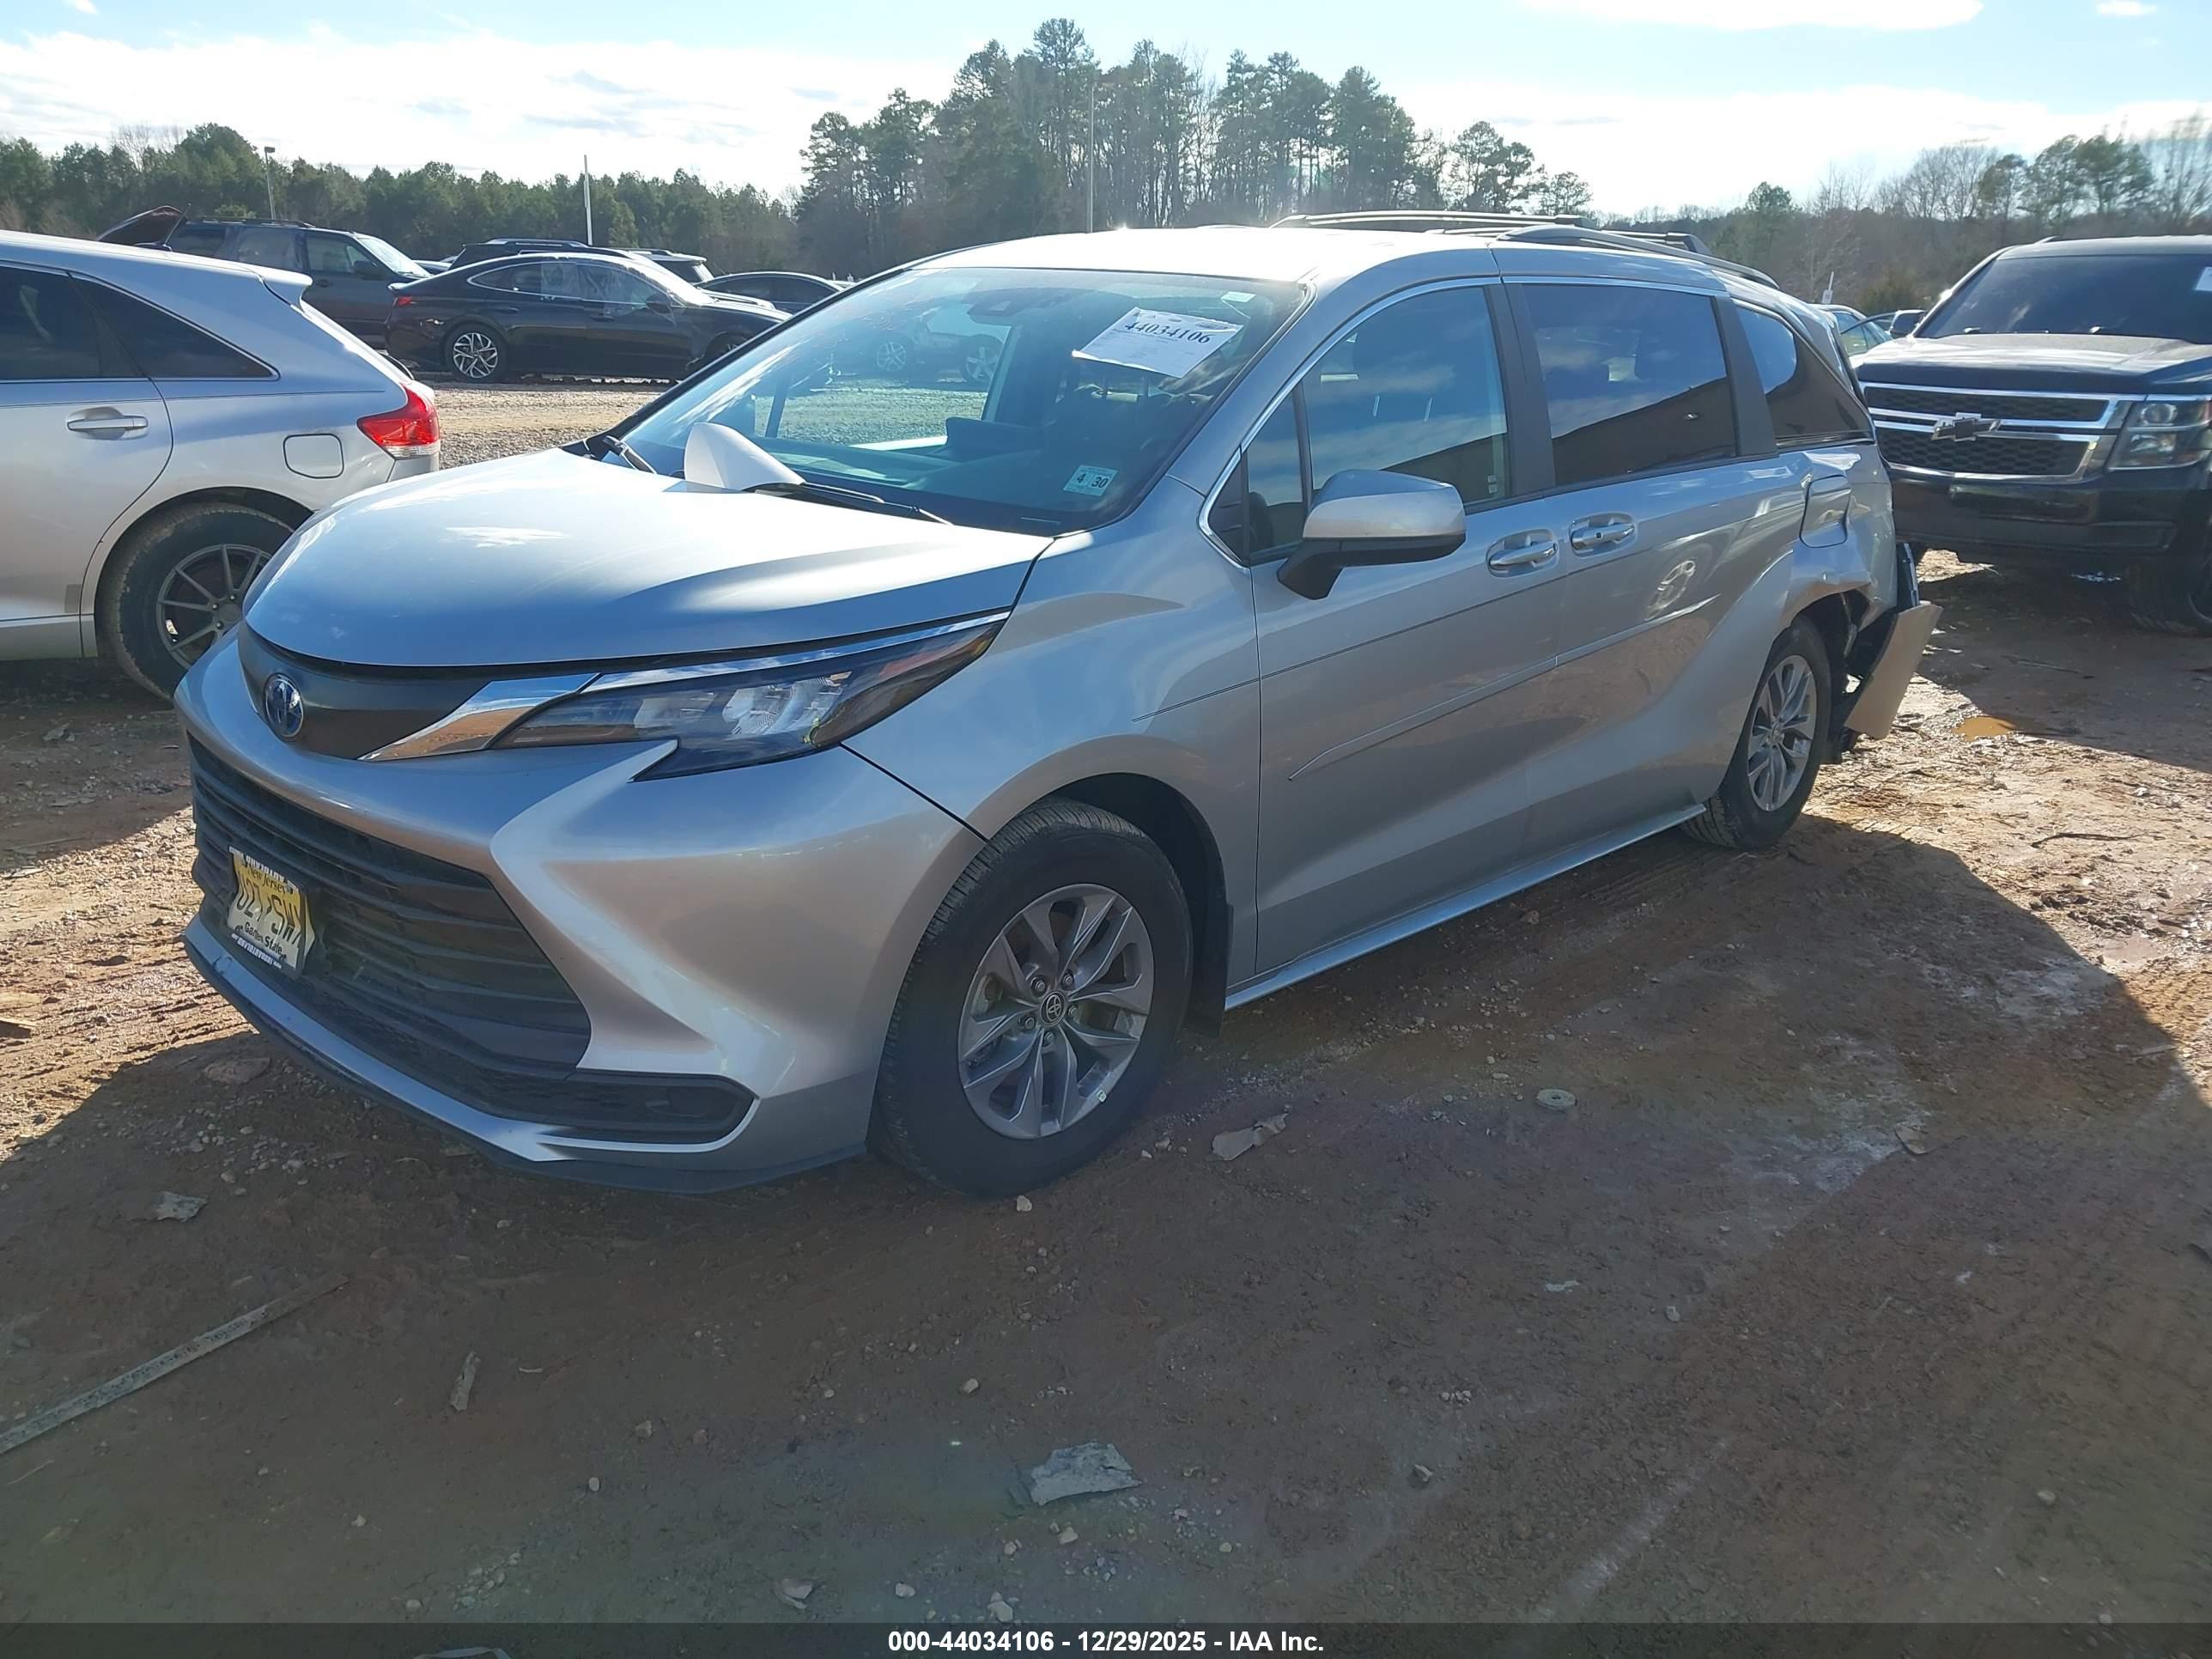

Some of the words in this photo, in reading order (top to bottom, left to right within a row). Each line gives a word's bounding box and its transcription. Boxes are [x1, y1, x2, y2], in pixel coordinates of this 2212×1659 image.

[1125, 320, 1213, 343] 44034106
[1077, 473, 1086, 483] 4
[1091, 477, 1109, 488] 30
[264, 936, 283, 955] State
